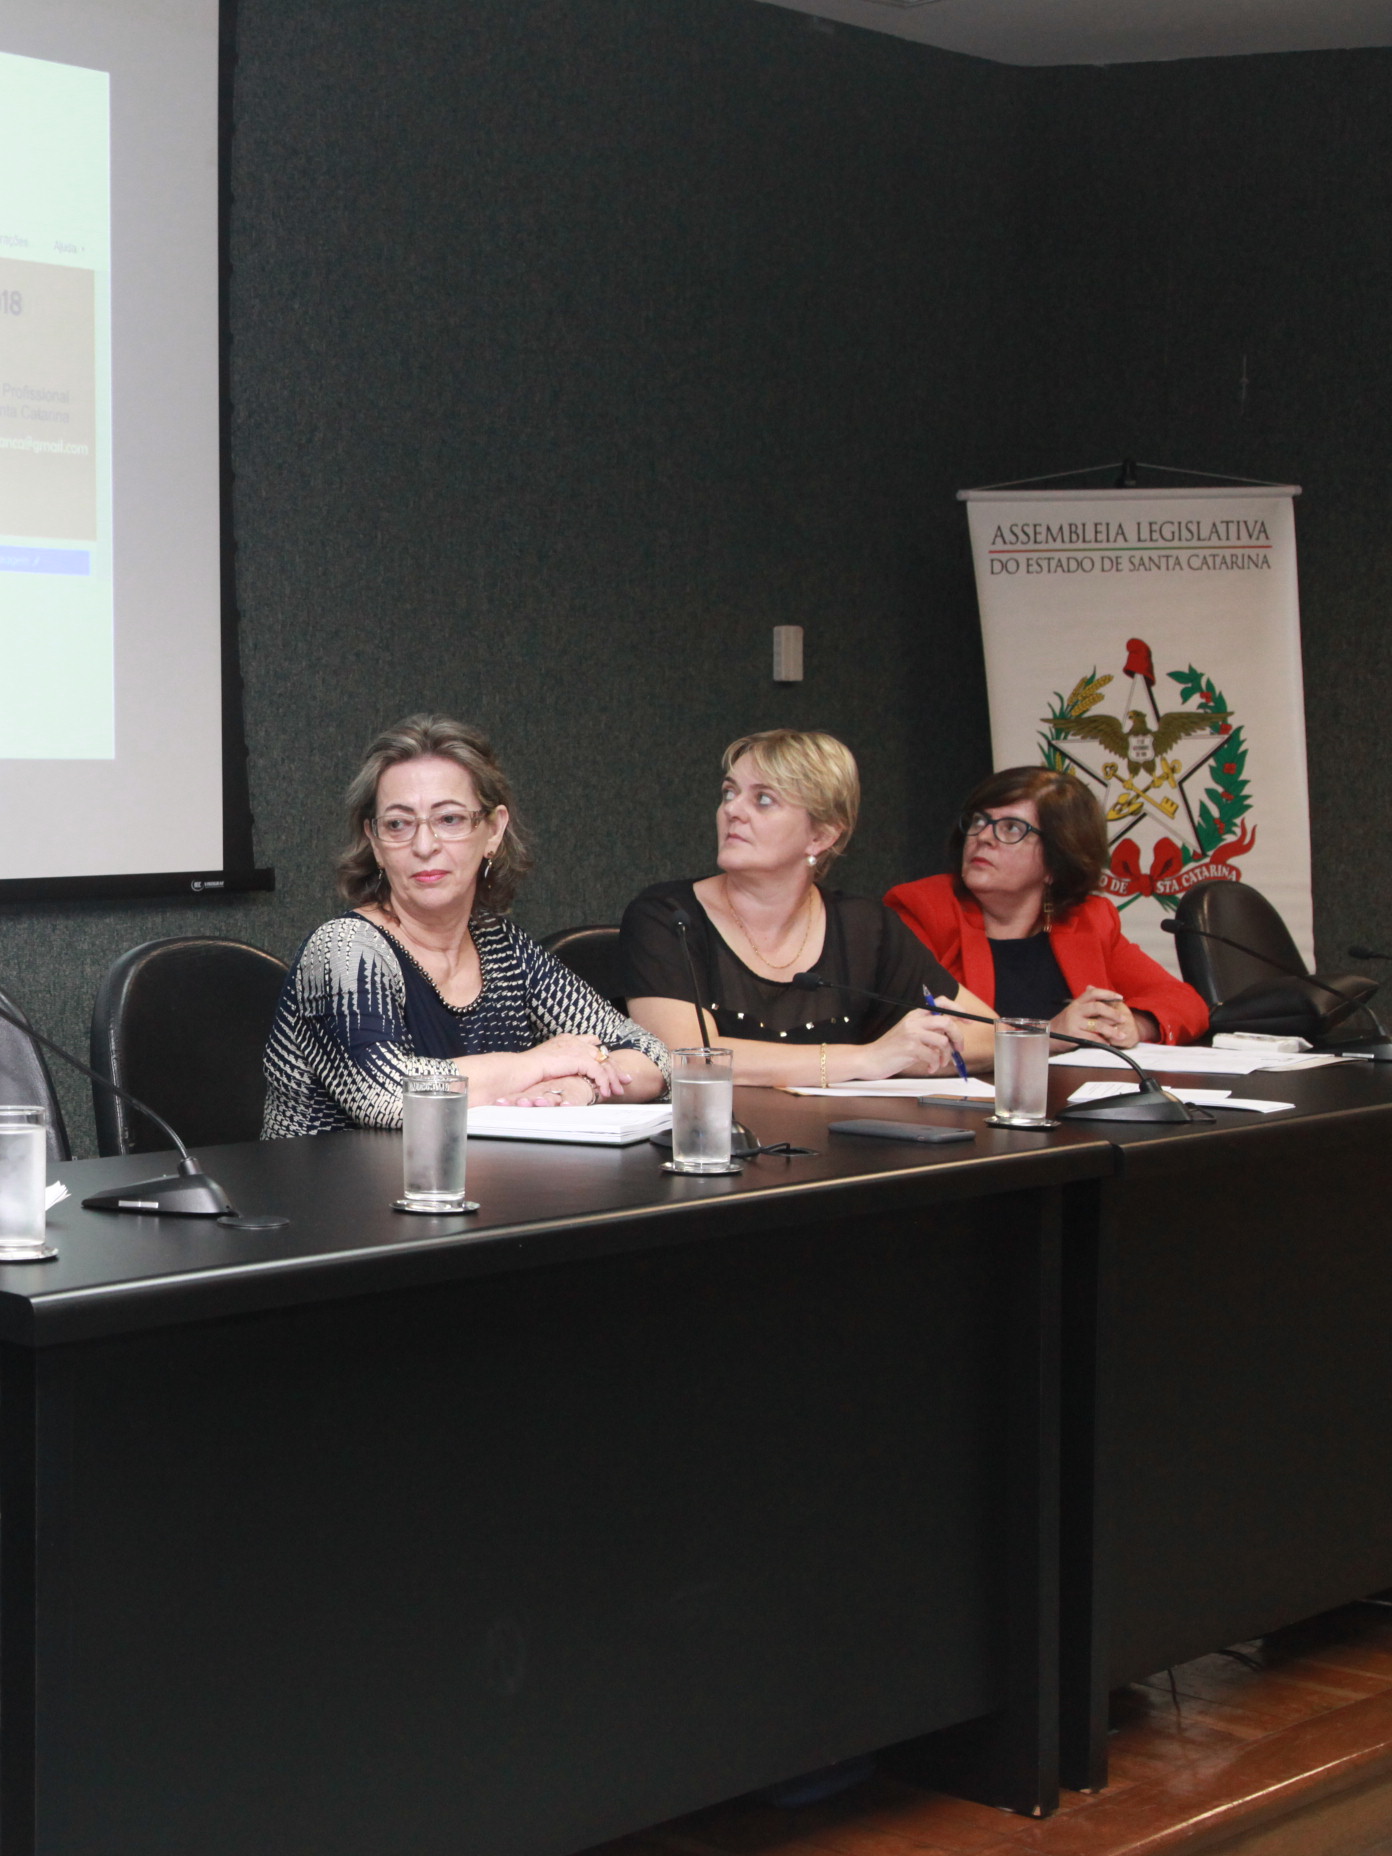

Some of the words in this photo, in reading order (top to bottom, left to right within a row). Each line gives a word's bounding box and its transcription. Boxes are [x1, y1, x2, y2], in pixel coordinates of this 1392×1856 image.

[2, 382, 70, 404] Profissional
[990, 521, 1130, 546] ASSEMBLEIA
[1136, 519, 1272, 544] LEGISLATIVA
[989, 557, 1021, 576] DO
[1025, 555, 1096, 575] ESTADO
[1100, 554, 1125, 574] DE
[1128, 553, 1183, 572] SANTA
[1186, 552, 1273, 571] CATARINA
[1109, 879, 1129, 895] DE
[1181, 863, 1238, 889] CATARINA
